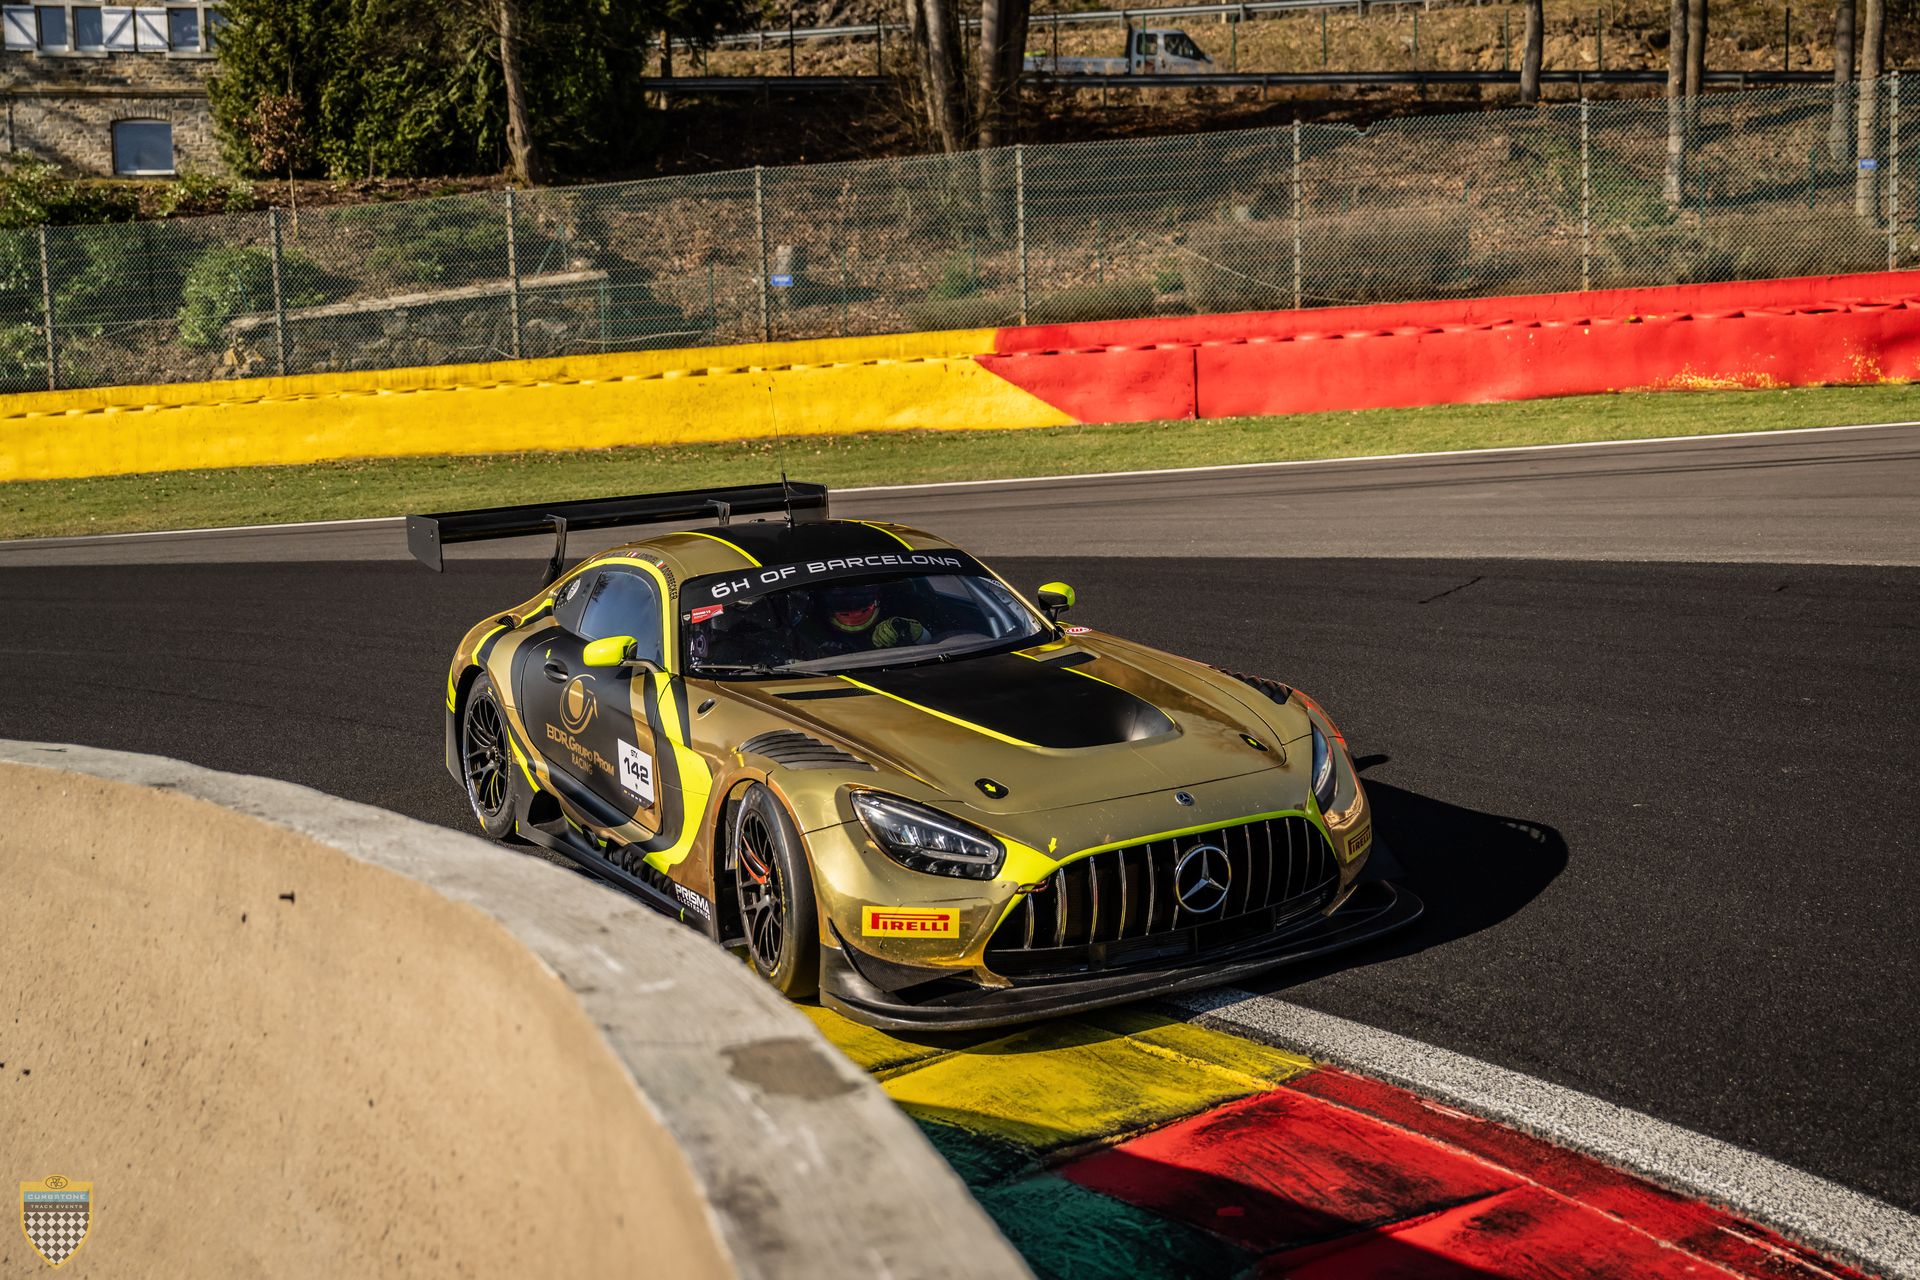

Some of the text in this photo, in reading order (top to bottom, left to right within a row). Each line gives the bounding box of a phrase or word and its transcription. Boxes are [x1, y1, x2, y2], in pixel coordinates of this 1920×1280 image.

[711, 555, 962, 599] 6H OF BARCELONA
[545, 723, 570, 750] BDR
[593, 751, 615, 777] PROM
[571, 753, 593, 775] RACING
[623, 757, 650, 786] 142
[1347, 824, 1371, 856] PIRELLI
[674, 883, 711, 914] PRISMA
[871, 912, 950, 932] PIRELLI
